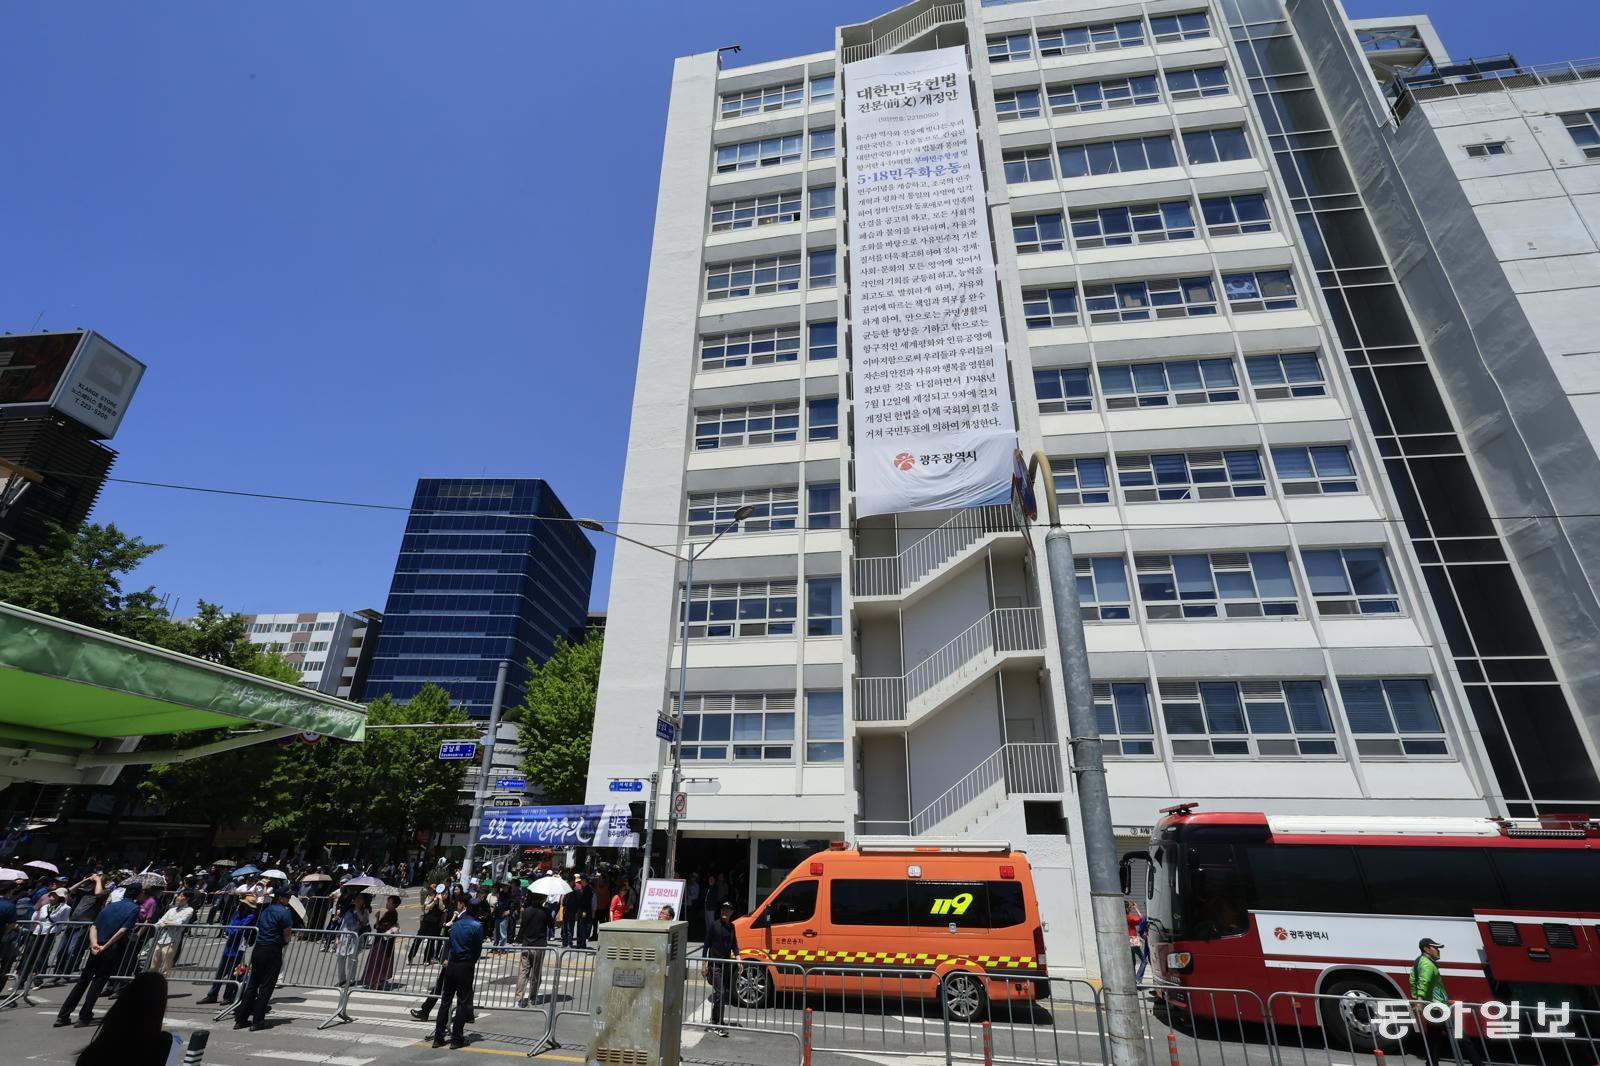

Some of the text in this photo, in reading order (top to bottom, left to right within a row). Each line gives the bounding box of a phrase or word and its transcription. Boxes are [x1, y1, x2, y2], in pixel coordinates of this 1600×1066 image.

[857, 73, 956, 100] 대한민국헌법
[919, 89, 958, 106] 개정안
[919, 450, 977, 465] 광주광역시
[930, 893, 973, 915] 119
[1289, 930, 1329, 940] 광주광역시
